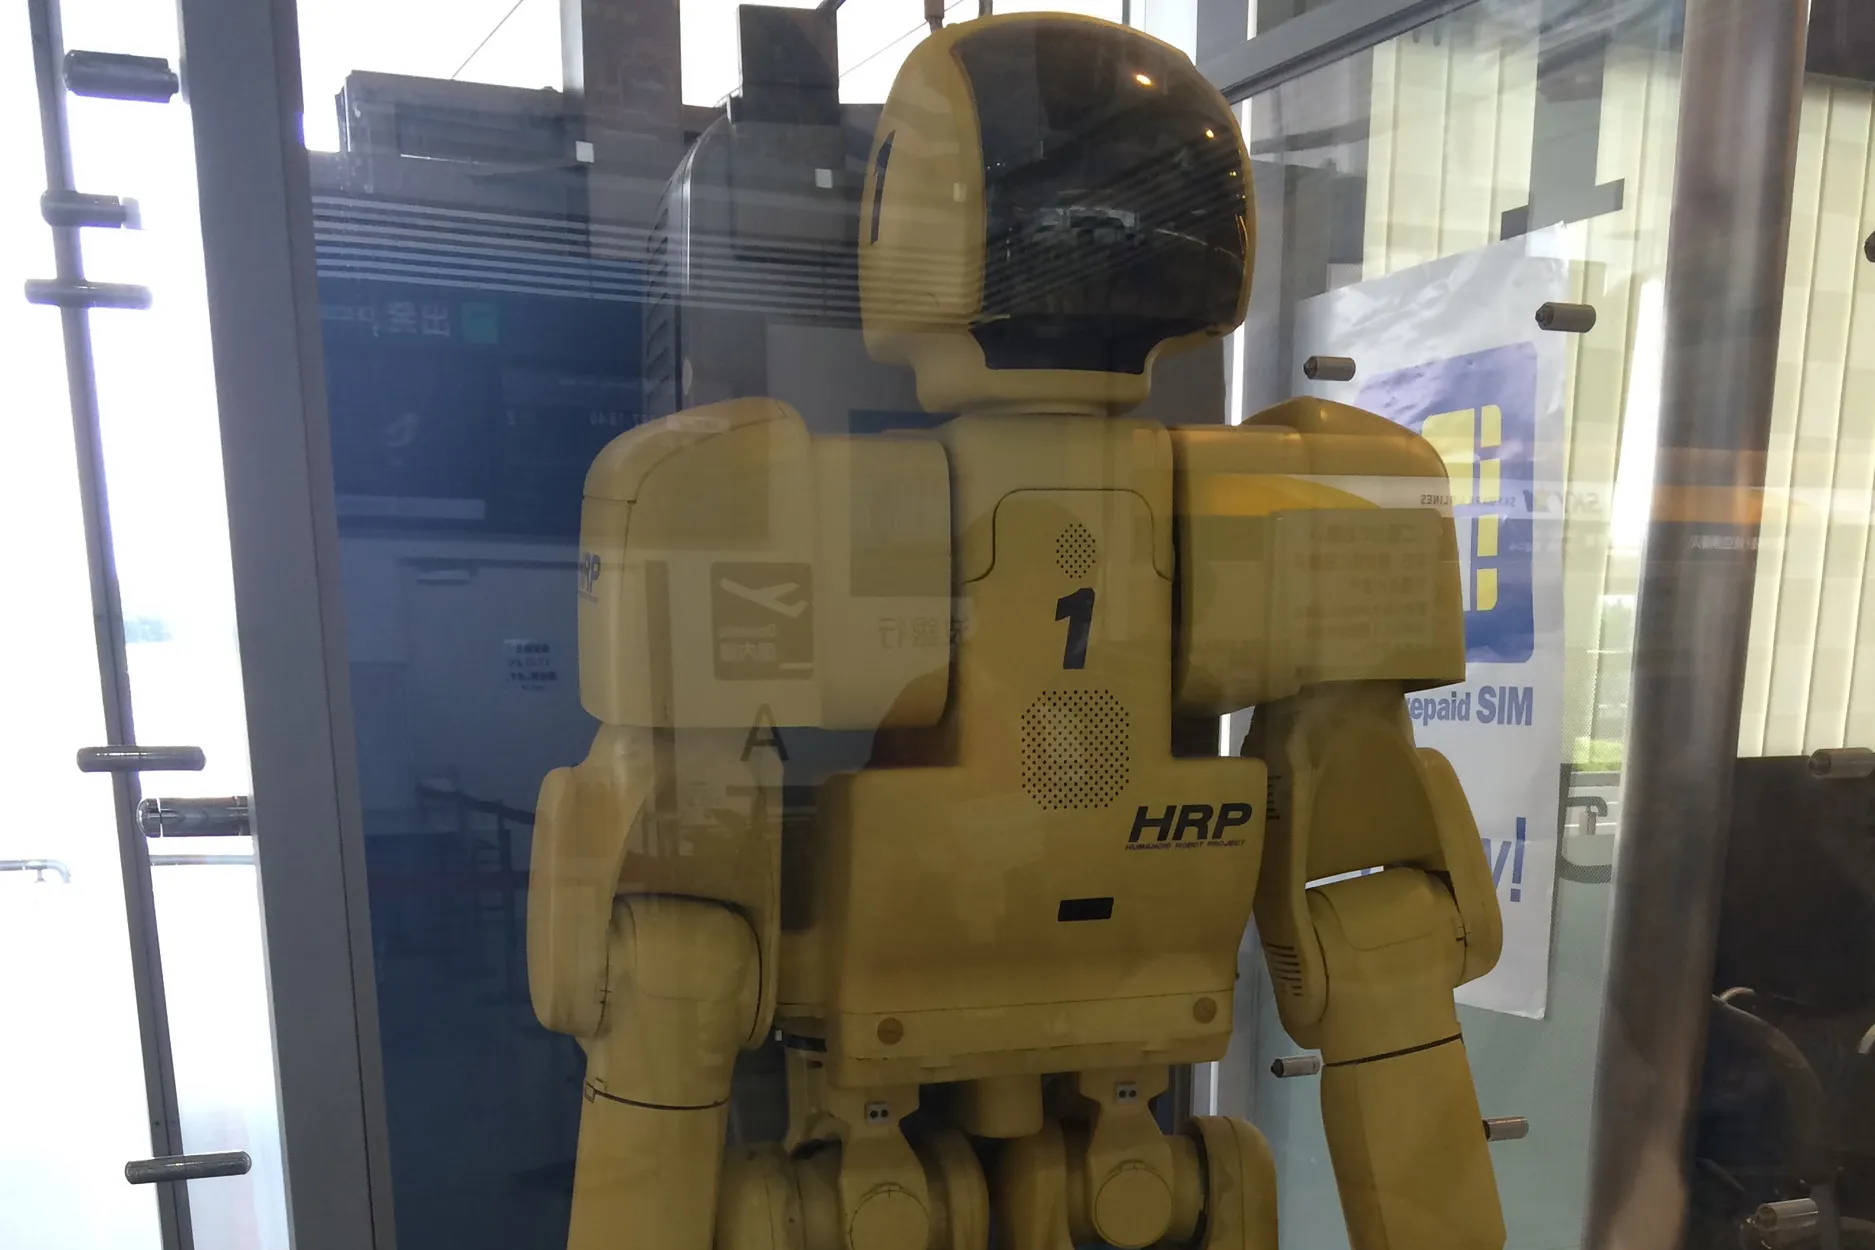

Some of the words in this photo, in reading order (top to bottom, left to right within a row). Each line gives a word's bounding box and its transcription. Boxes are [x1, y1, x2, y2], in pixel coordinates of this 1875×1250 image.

[1055, 587, 1095, 669] 1
[1476, 685, 1534, 726] SIM
[1128, 803, 1253, 843] HRP
